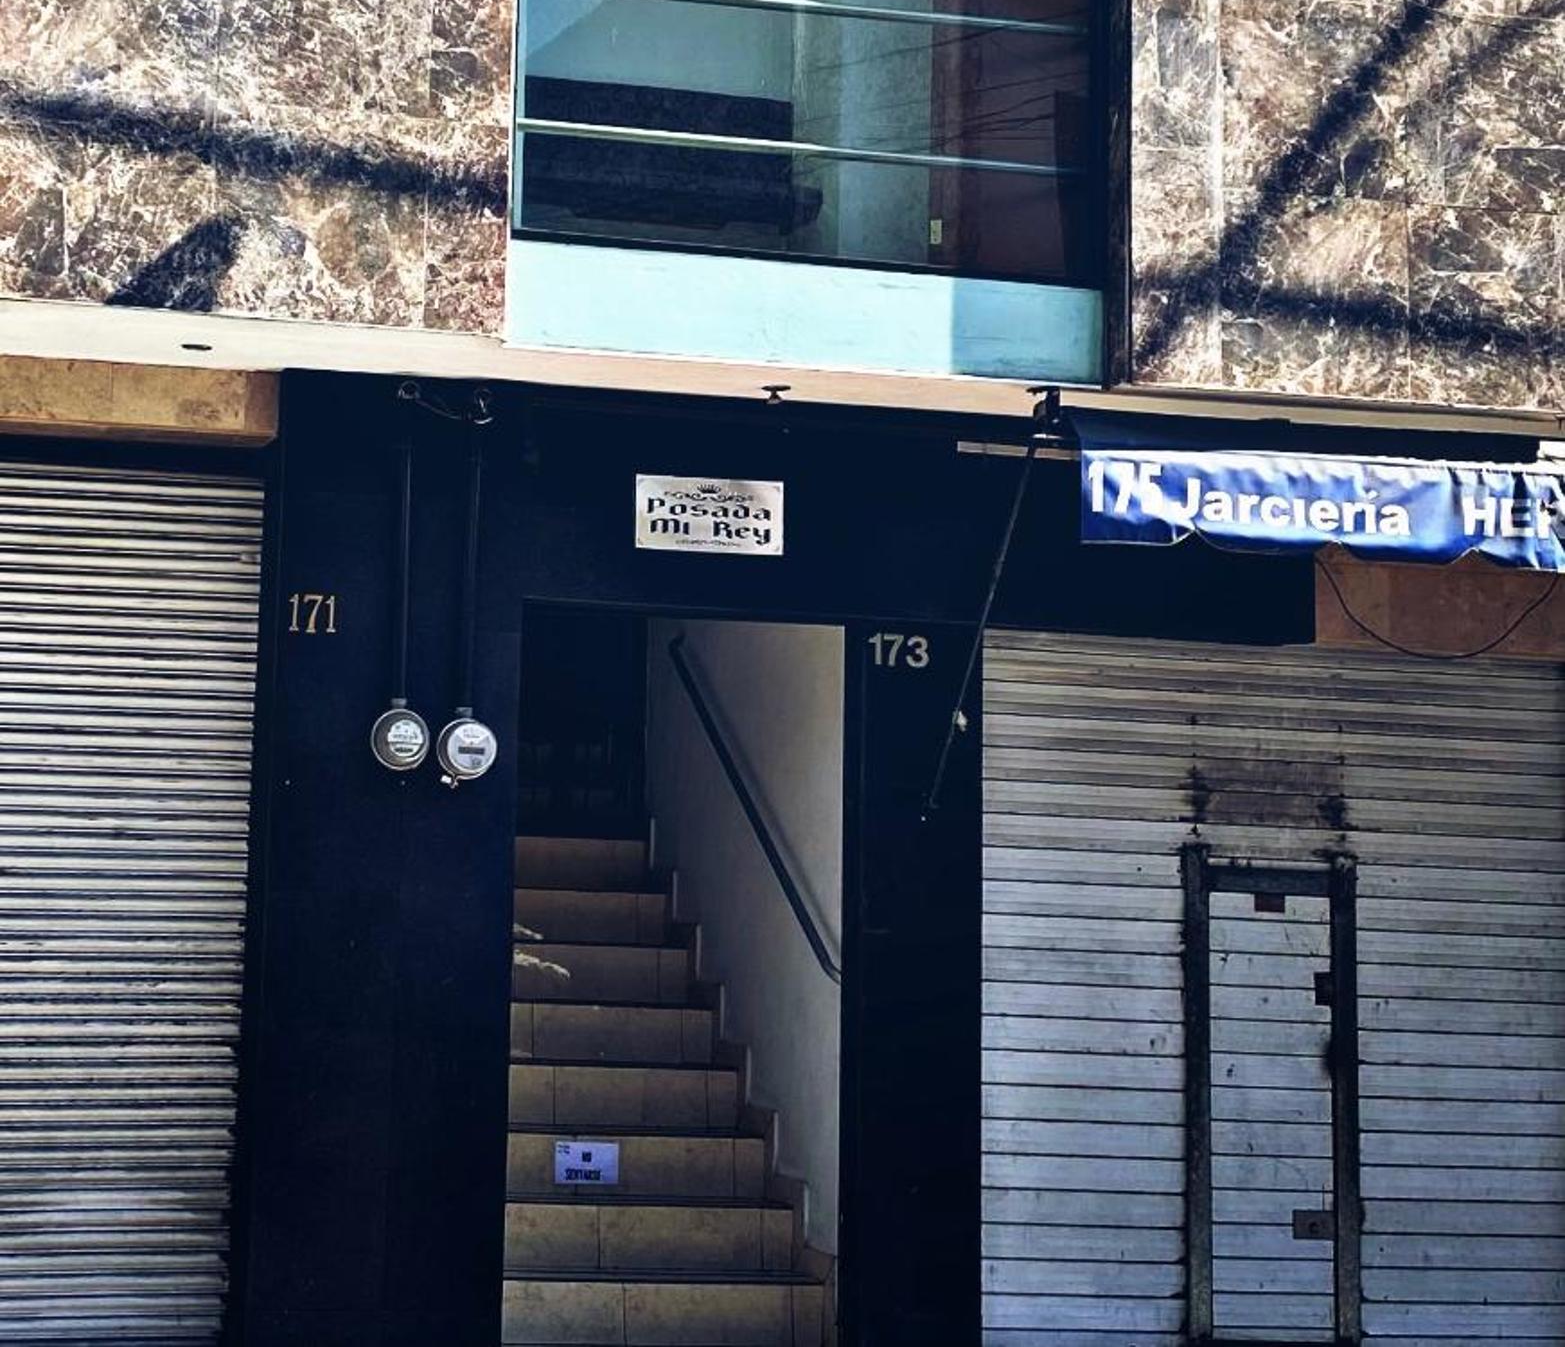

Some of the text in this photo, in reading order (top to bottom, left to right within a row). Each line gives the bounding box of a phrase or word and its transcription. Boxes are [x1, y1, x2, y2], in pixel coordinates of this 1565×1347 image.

[647, 497, 772, 521] Posada
[713, 521, 771, 545] Rey
[289, 594, 336, 633] 171
[868, 633, 930, 668] 173
